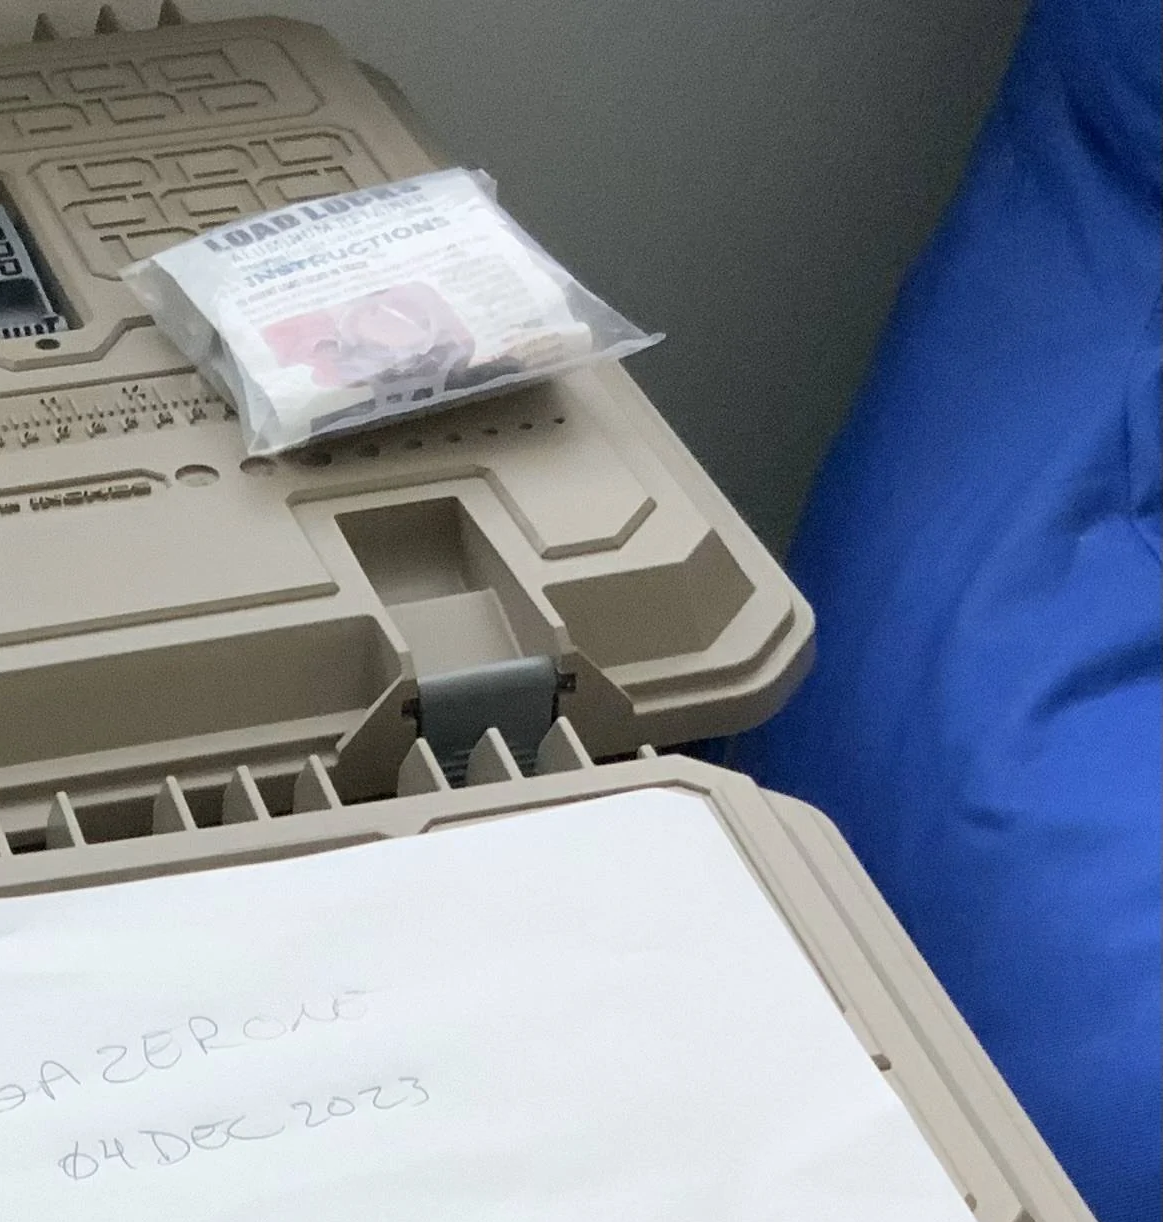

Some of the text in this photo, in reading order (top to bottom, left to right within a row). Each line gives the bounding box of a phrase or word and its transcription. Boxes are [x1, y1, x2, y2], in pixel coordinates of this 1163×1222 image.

[204, 212, 302, 253] LOAD
[242, 215, 451, 289] INSTRUCTIONS
[138, 1114, 285, 1166] DEC
[291, 1076, 430, 1127] 2023
